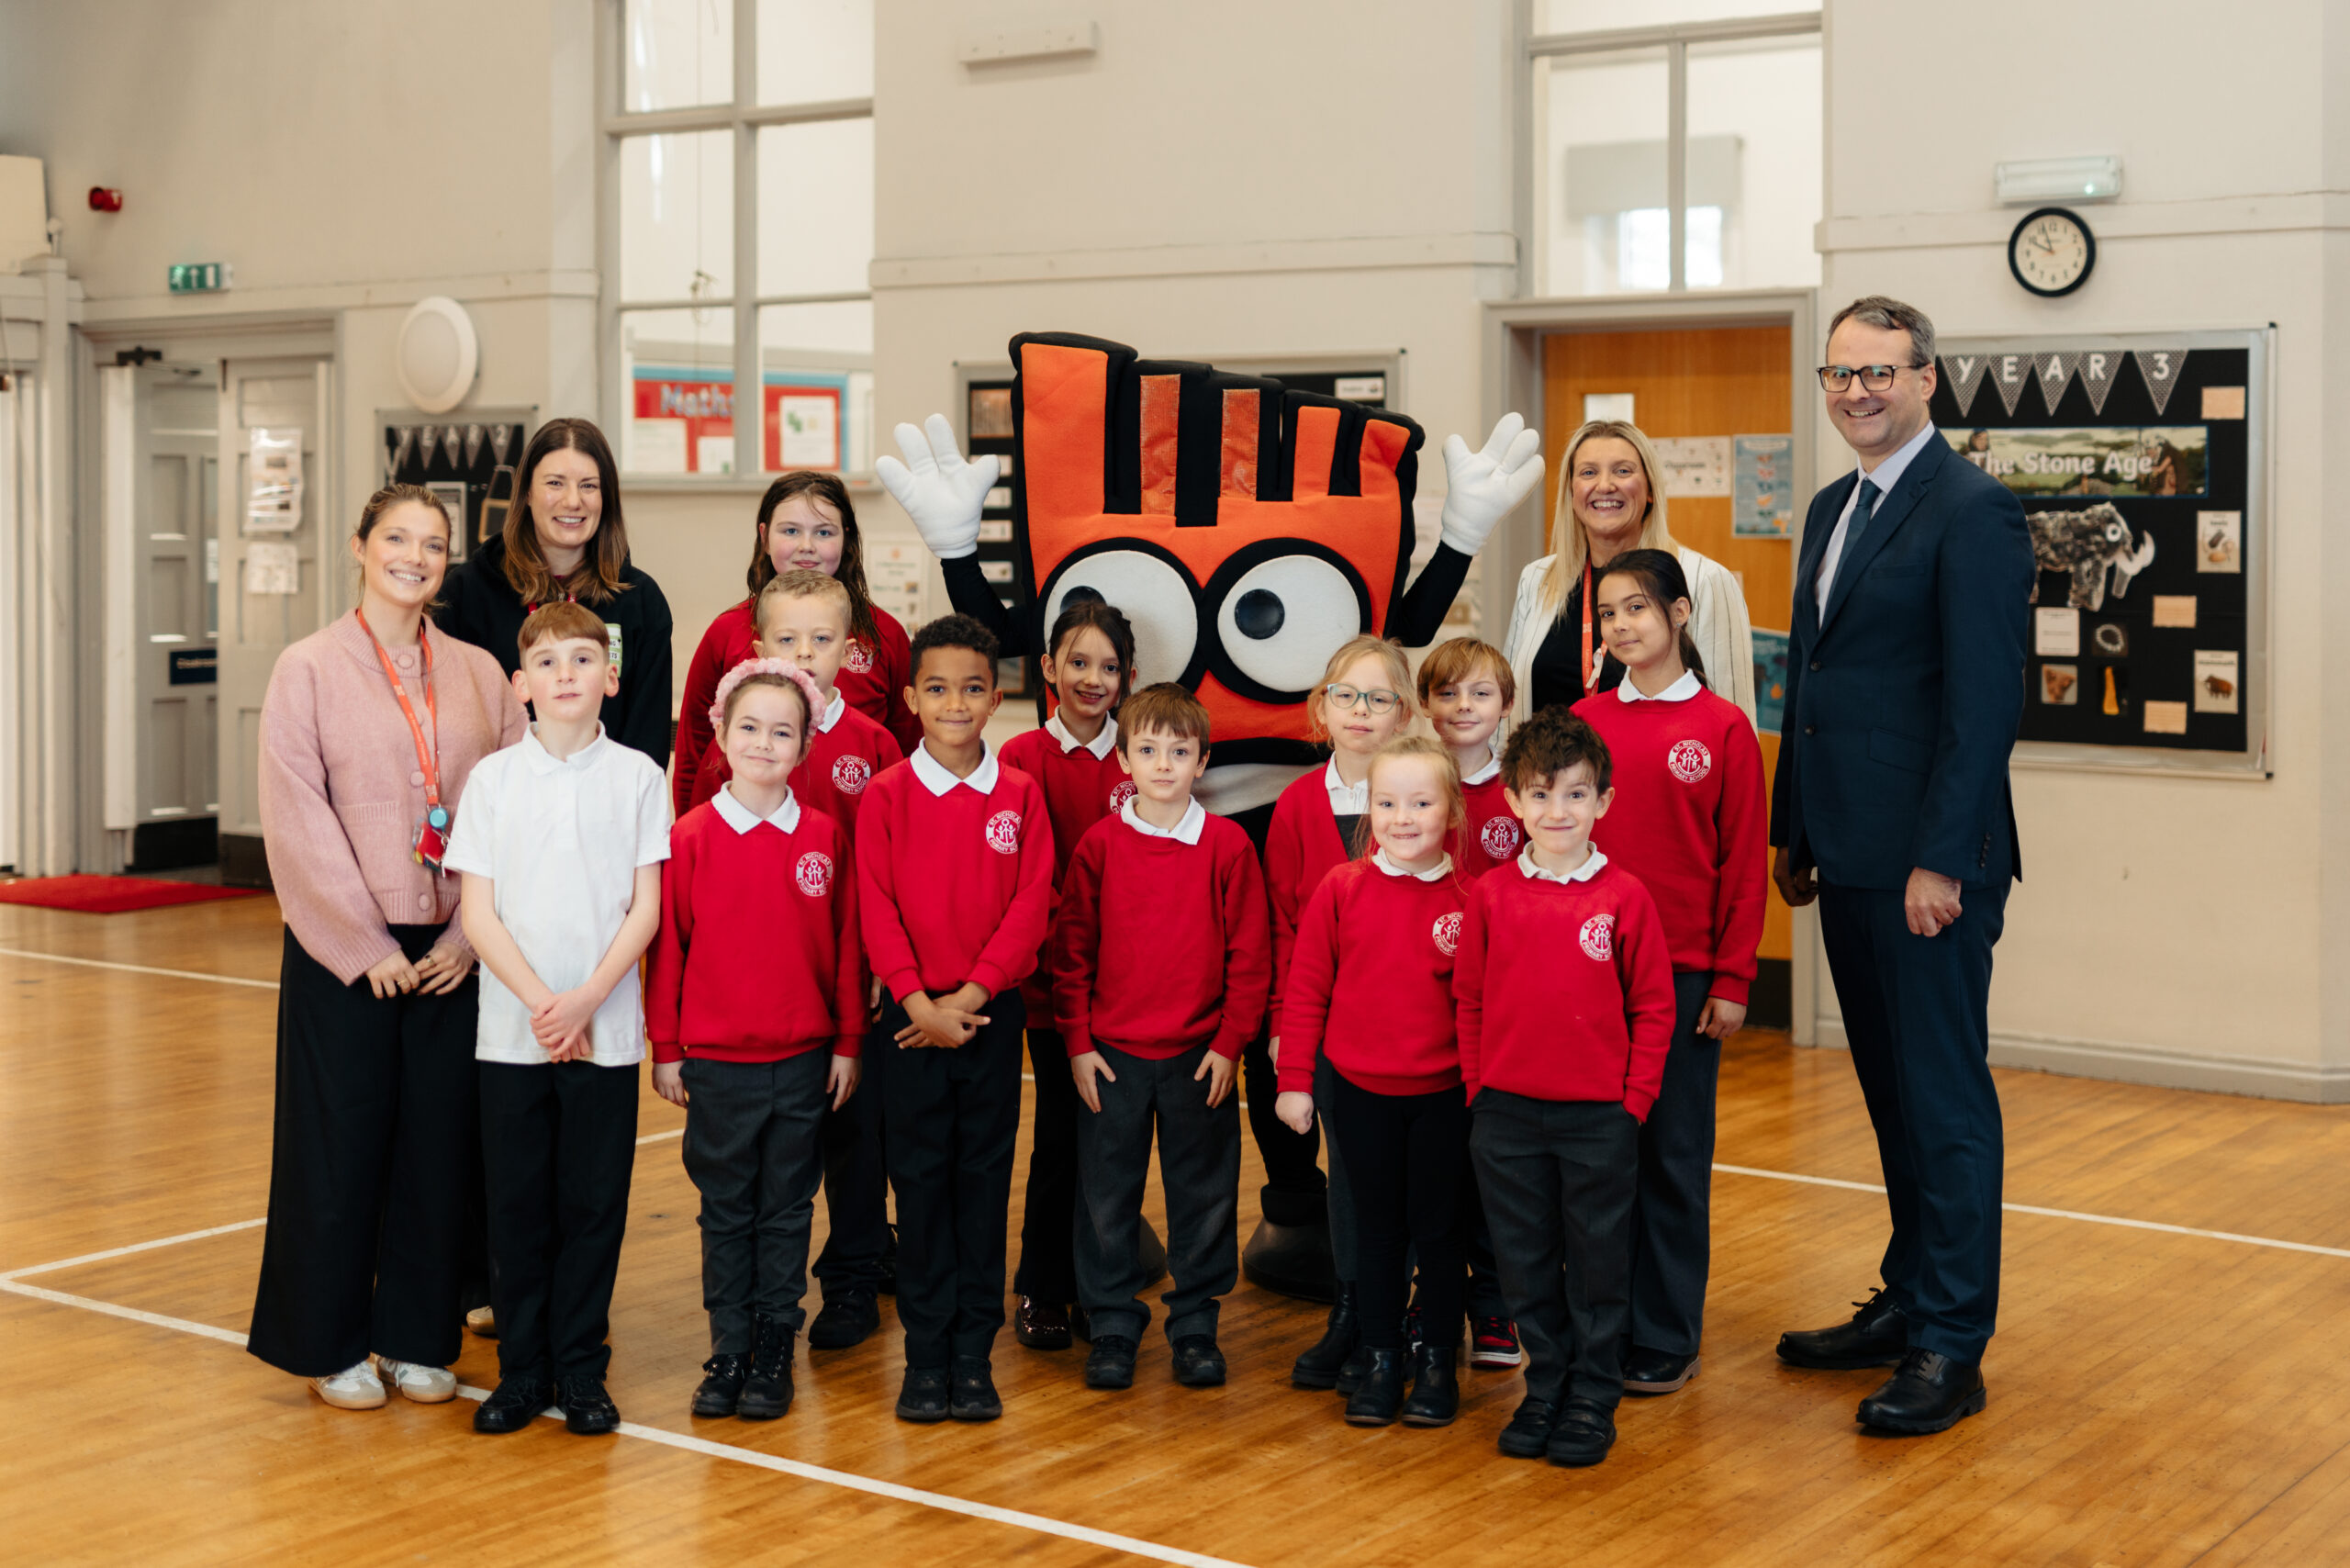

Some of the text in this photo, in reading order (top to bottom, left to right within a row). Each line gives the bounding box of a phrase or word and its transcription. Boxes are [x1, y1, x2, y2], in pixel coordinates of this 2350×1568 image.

[1957, 353, 2170, 383] YEAR 3
[400, 423, 508, 447] YEAR 2
[1969, 450, 2153, 481] The Stone Age
